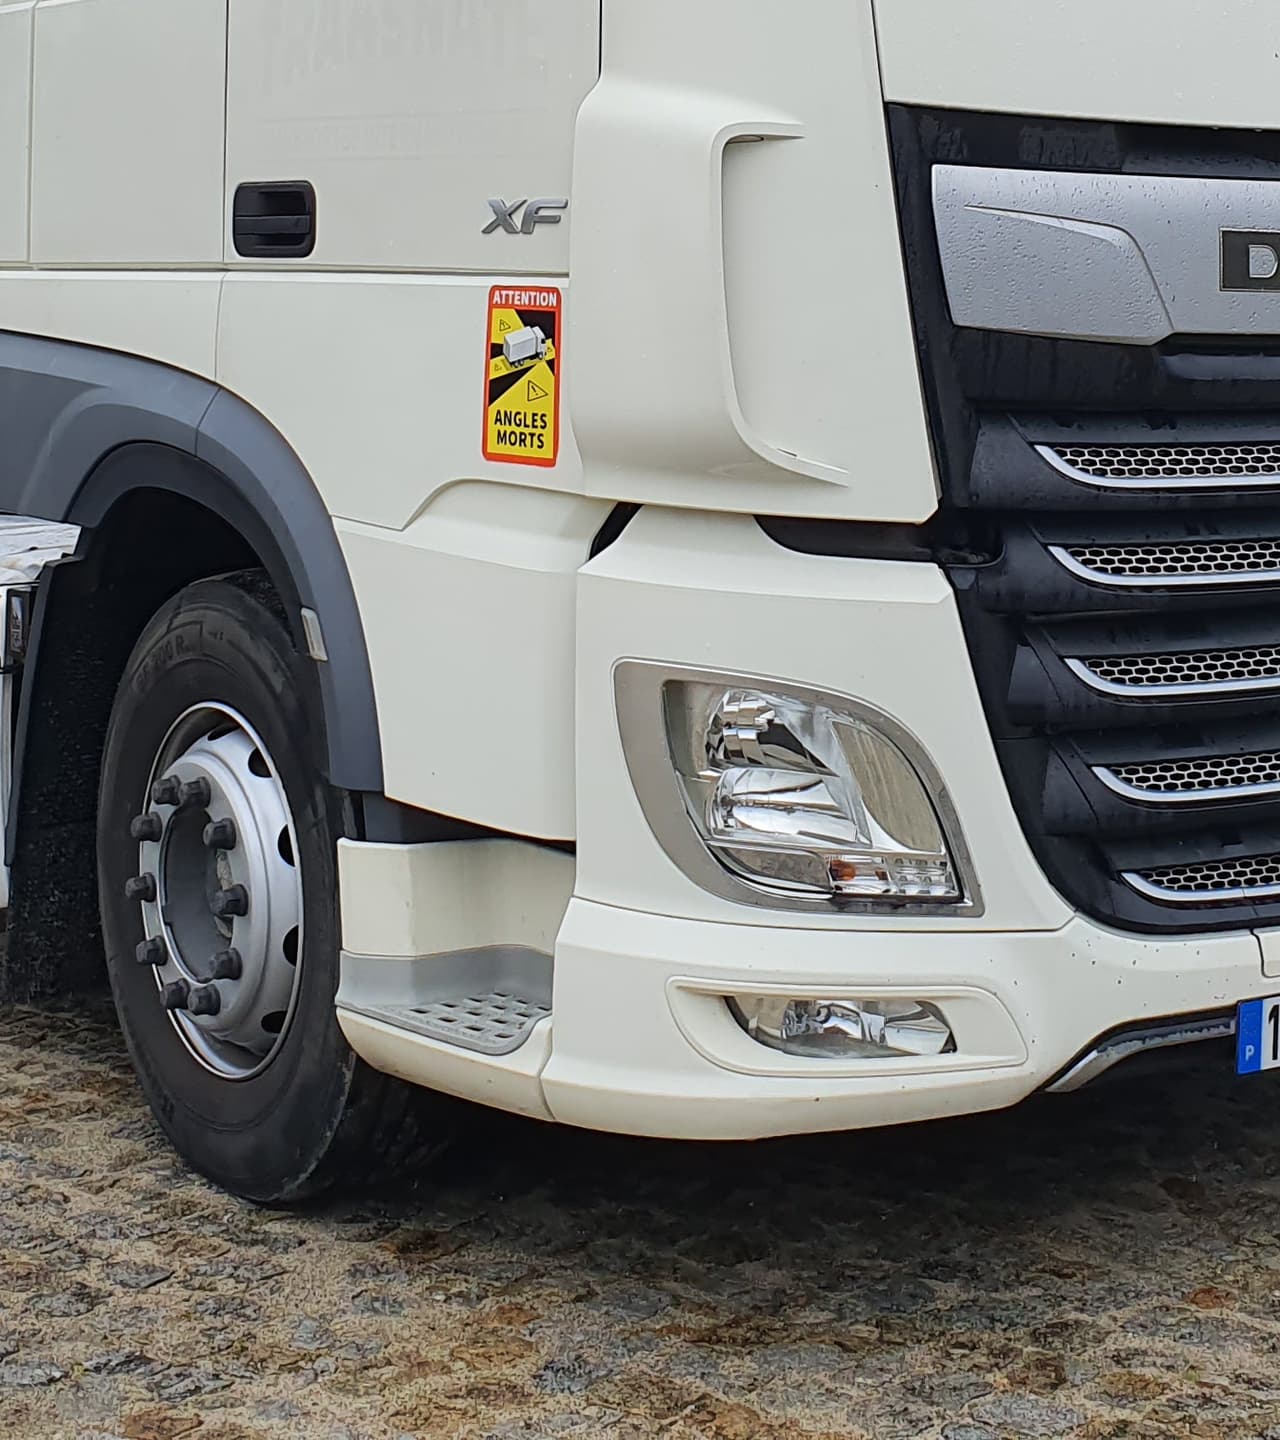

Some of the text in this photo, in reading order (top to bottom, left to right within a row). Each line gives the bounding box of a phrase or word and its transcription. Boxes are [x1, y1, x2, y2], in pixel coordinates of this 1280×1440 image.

[481, 198, 568, 235] XF
[492, 290, 557, 307] ATTENTION
[494, 409, 548, 430] ANGLES
[496, 429, 545, 450] MORTS
[1244, 1044, 1255, 1061] P
